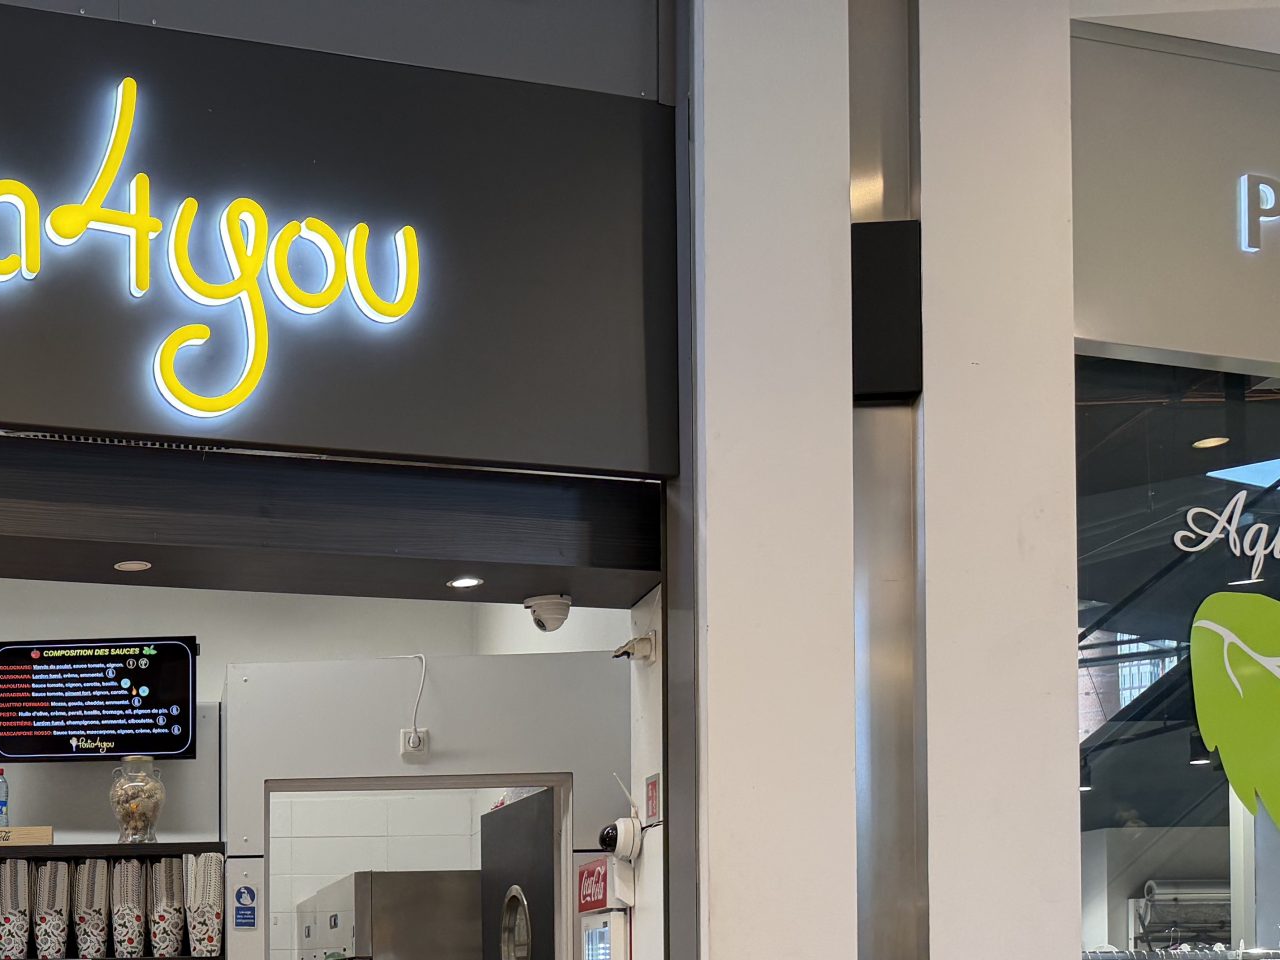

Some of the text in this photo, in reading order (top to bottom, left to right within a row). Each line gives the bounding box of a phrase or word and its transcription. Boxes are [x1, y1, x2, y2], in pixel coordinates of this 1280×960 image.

[43, 649, 93, 657] COMPOSITION
[94, 648, 109, 656] DES
[79, 737, 115, 753] Pasta4you
[581, 865, 605, 904] Coca-Cola
